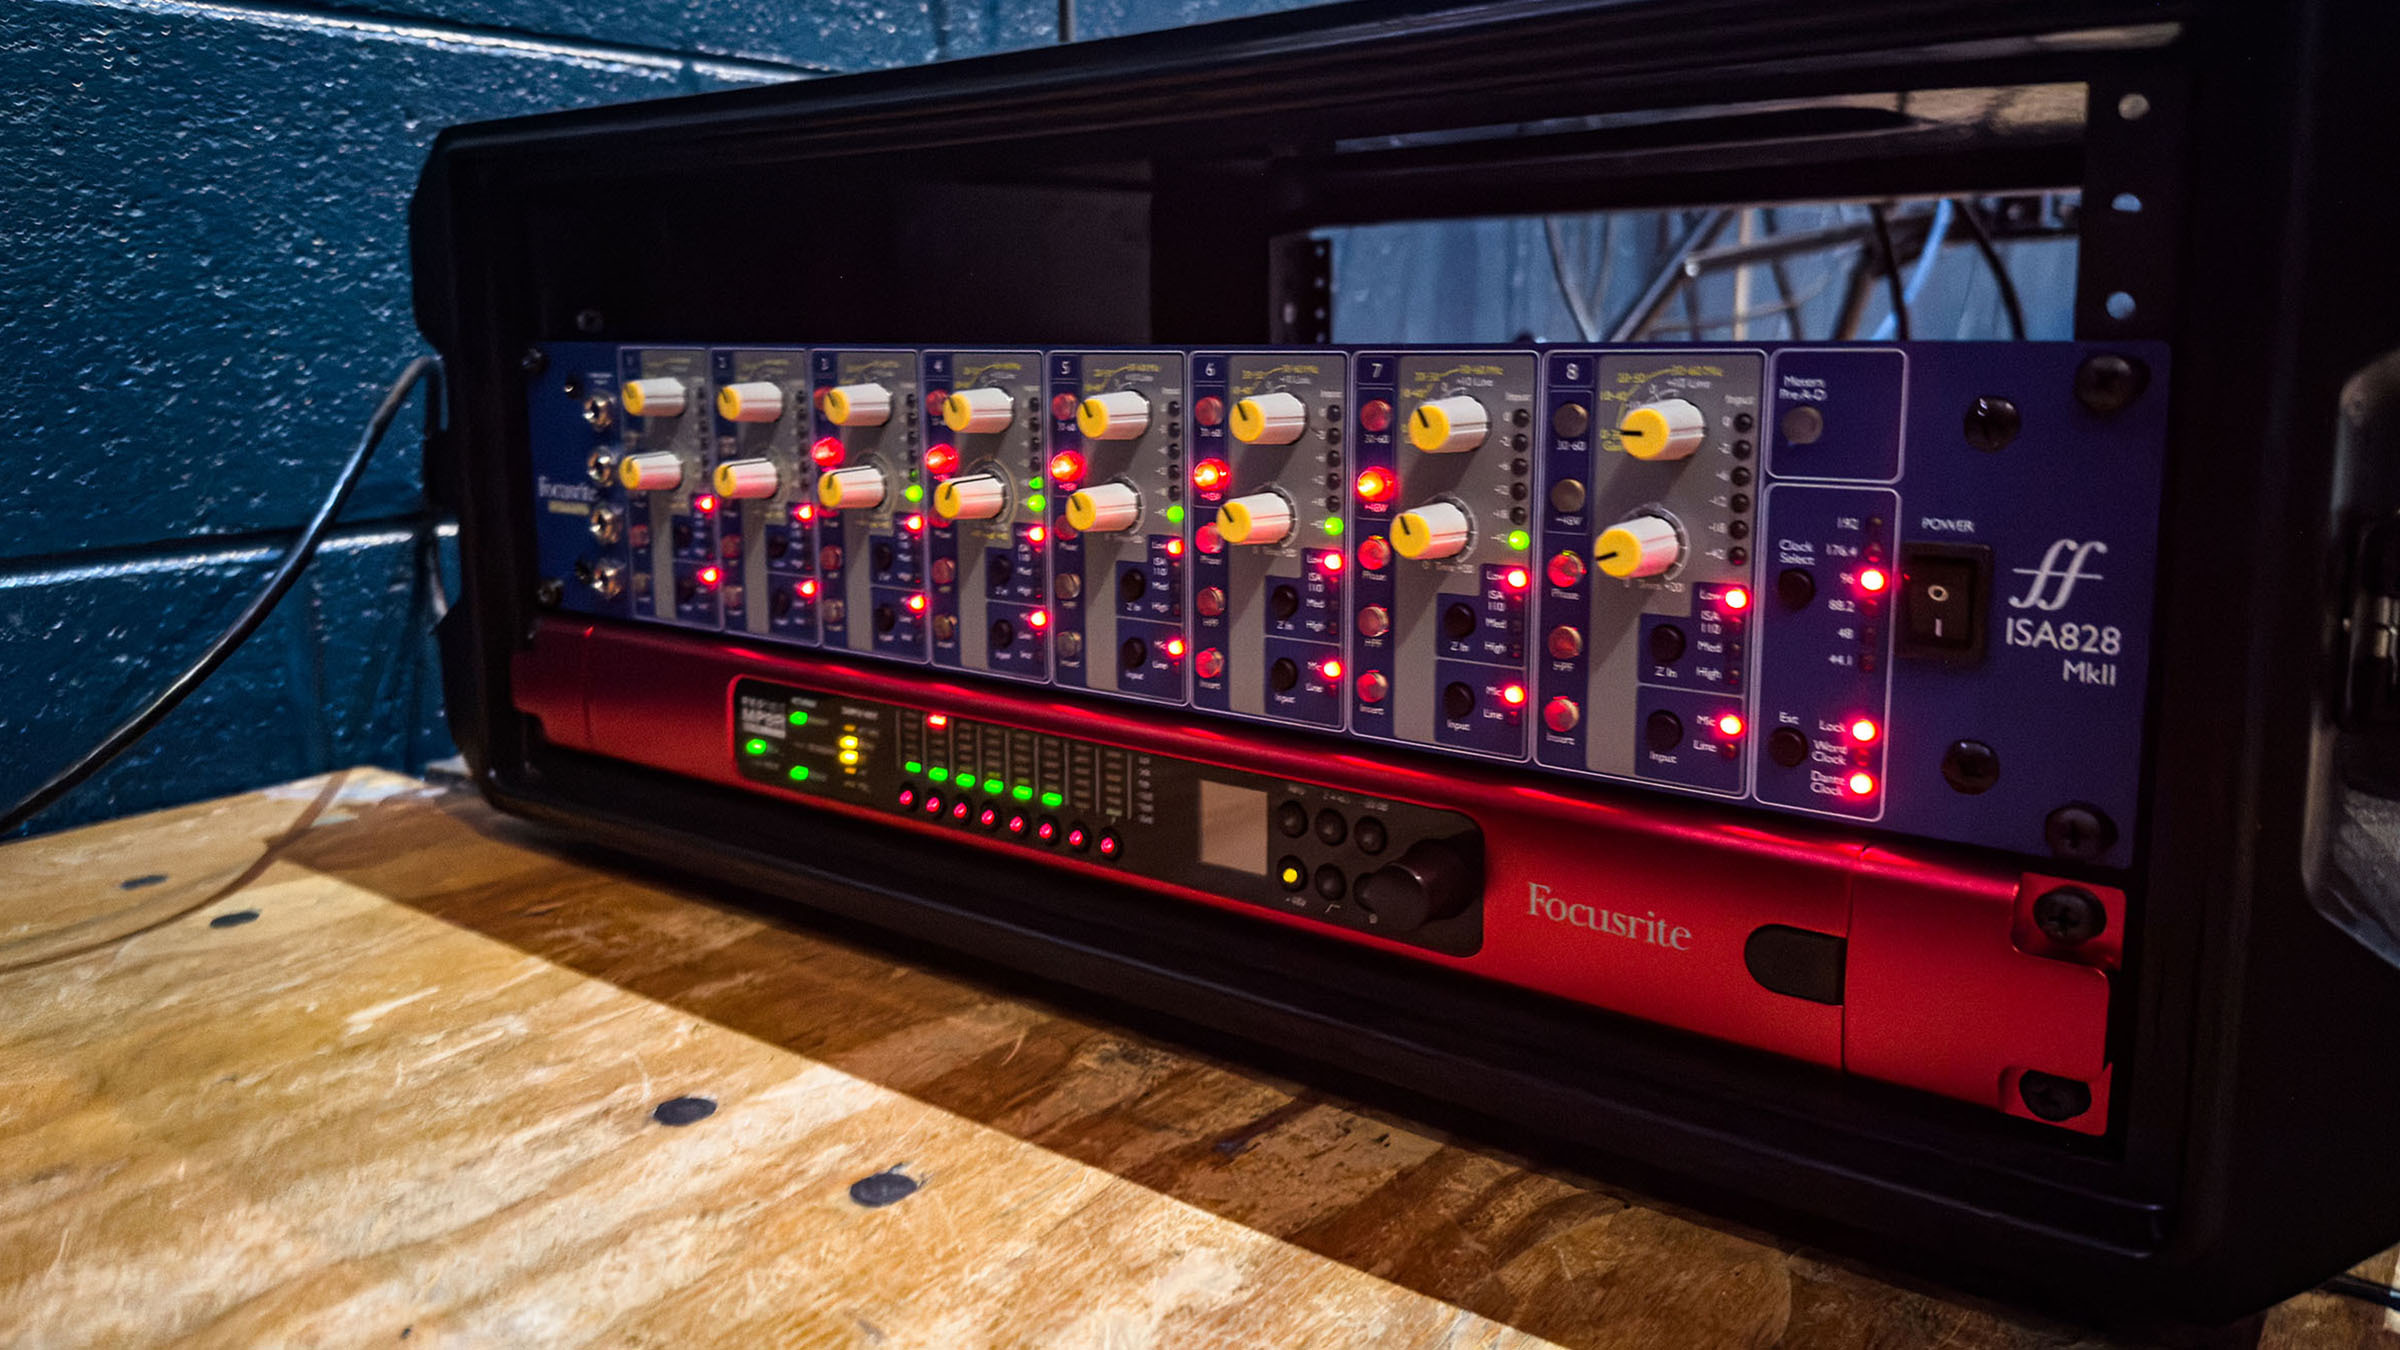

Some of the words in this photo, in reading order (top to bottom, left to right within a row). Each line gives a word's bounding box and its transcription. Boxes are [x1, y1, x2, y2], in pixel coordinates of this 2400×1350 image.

[1061, 361, 1070, 375] 5
[1205, 363, 1215, 376] 6
[1371, 363, 1383, 378] 7
[1566, 363, 1579, 380] 8
[1783, 375, 1825, 388] Meters
[1837, 517, 1859, 530] 192
[1921, 517, 1975, 532] POWER
[1778, 539, 1814, 552] Clock
[1826, 543, 1858, 557] 176.4
[1779, 552, 1815, 566] Select
[1486, 570, 1505, 581] Low
[1840, 572, 1855, 585] 96
[1488, 589, 1505, 600] ISA
[1700, 589, 1722, 600] Low
[1488, 601, 1506, 612] 110
[1828, 599, 1855, 613] 88.2
[1701, 610, 1721, 621] ISA
[1485, 618, 1508, 629] Med
[1701, 623, 1722, 634] 110
[1838, 627, 1854, 640] 48
[2005, 617, 2121, 655] ISA828
[1484, 641, 1507, 655] High
[1697, 640, 1723, 653] Med
[1828, 654, 1853, 666] 44.1
[1655, 666, 1665, 677] Z
[1667, 668, 1678, 678] In
[1696, 666, 1722, 681] High
[2062, 659, 2116, 686] MkII
[1483, 708, 1503, 720] Line
[1779, 711, 1800, 725] Ext
[1447, 719, 1470, 732] Input
[1697, 715, 1716, 727] Mic
[1819, 719, 1846, 733] Lock
[1693, 740, 1717, 753] Line
[1813, 739, 1848, 755] Word
[1650, 752, 1678, 764] Input
[1811, 751, 1847, 766] Clock
[1810, 770, 1846, 786] Dante
[1810, 782, 1844, 797] Clock
[1528, 881, 1692, 951] Focusrite
